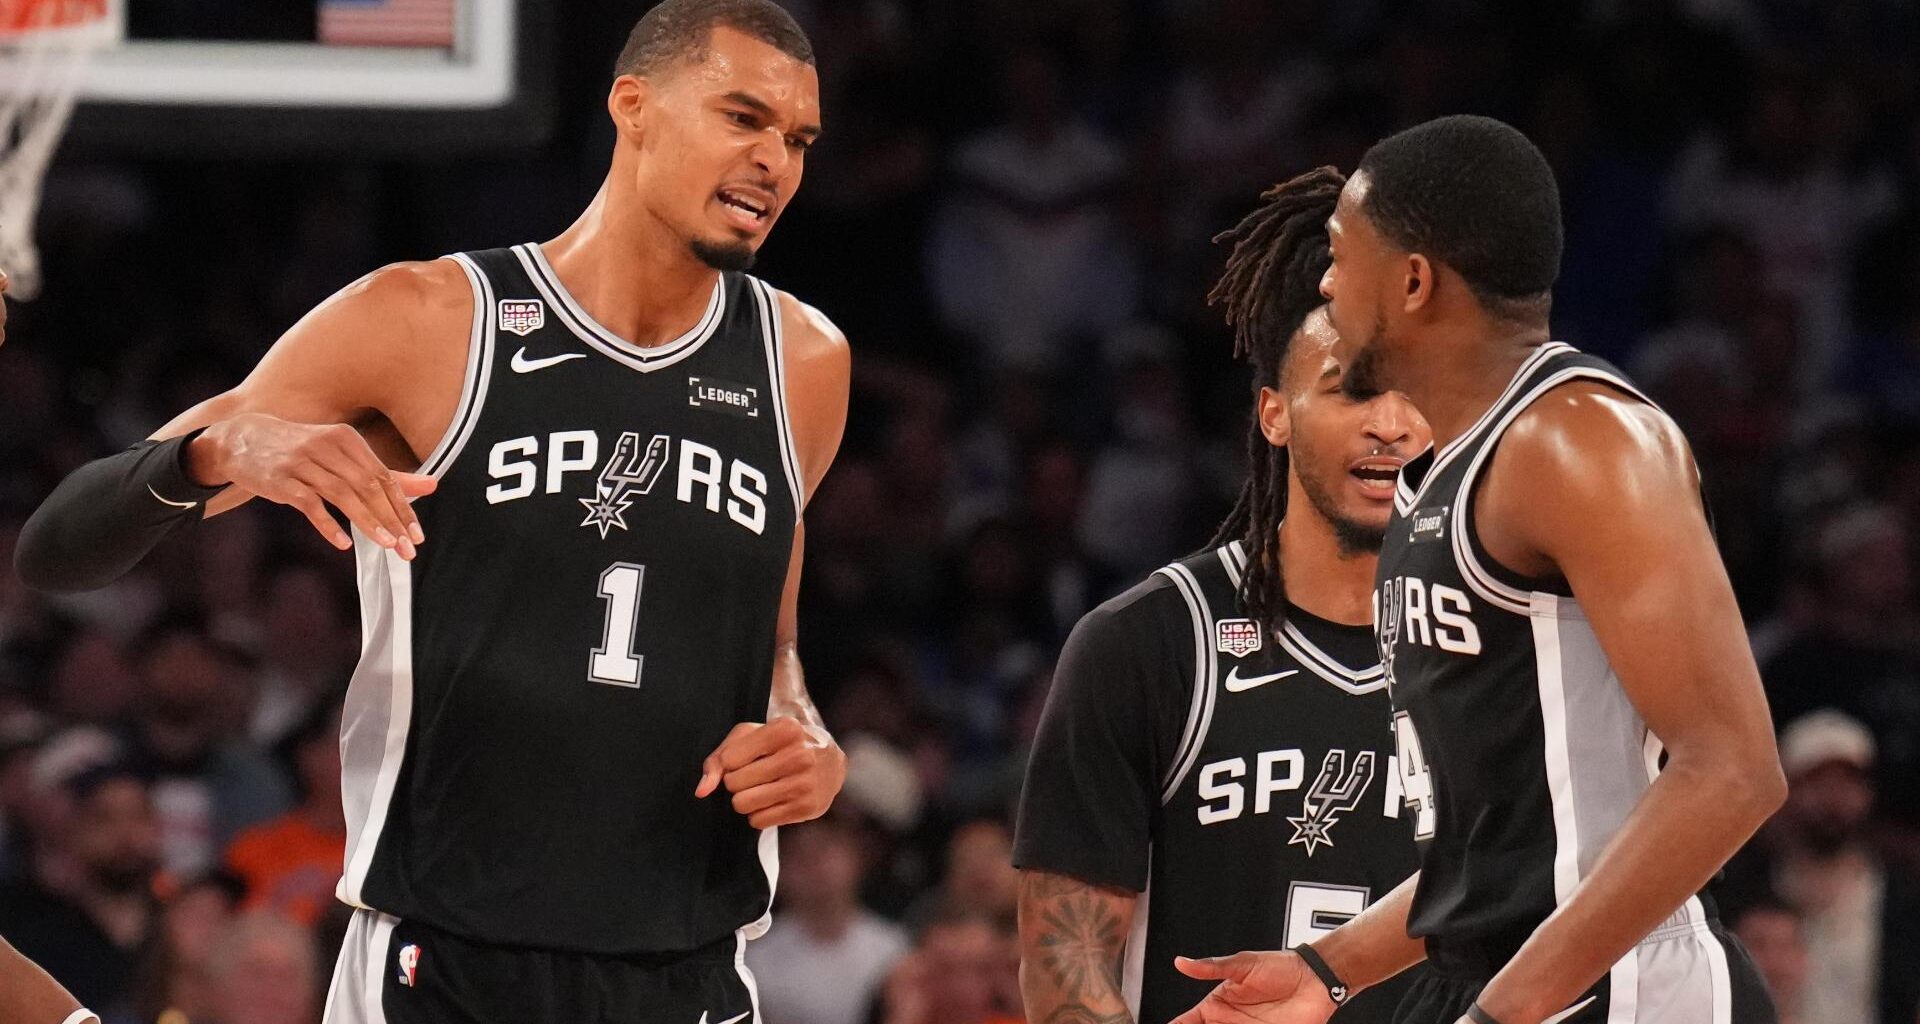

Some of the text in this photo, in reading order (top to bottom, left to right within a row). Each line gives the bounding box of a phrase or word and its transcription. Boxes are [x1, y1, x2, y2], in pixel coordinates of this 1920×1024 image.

[504, 304, 538, 313] USA
[503, 317, 540, 327] 250
[698, 386, 749, 408] LEDGER
[486, 430, 768, 540] SPURS
[1414, 515, 1442, 533] LEDGER
[587, 561, 646, 689] 1
[1221, 623, 1256, 633] USA
[1372, 576, 1482, 684] URS
[1221, 637, 1258, 649] 250
[1393, 710, 1436, 841] 4
[1197, 749, 1405, 857] SPU
